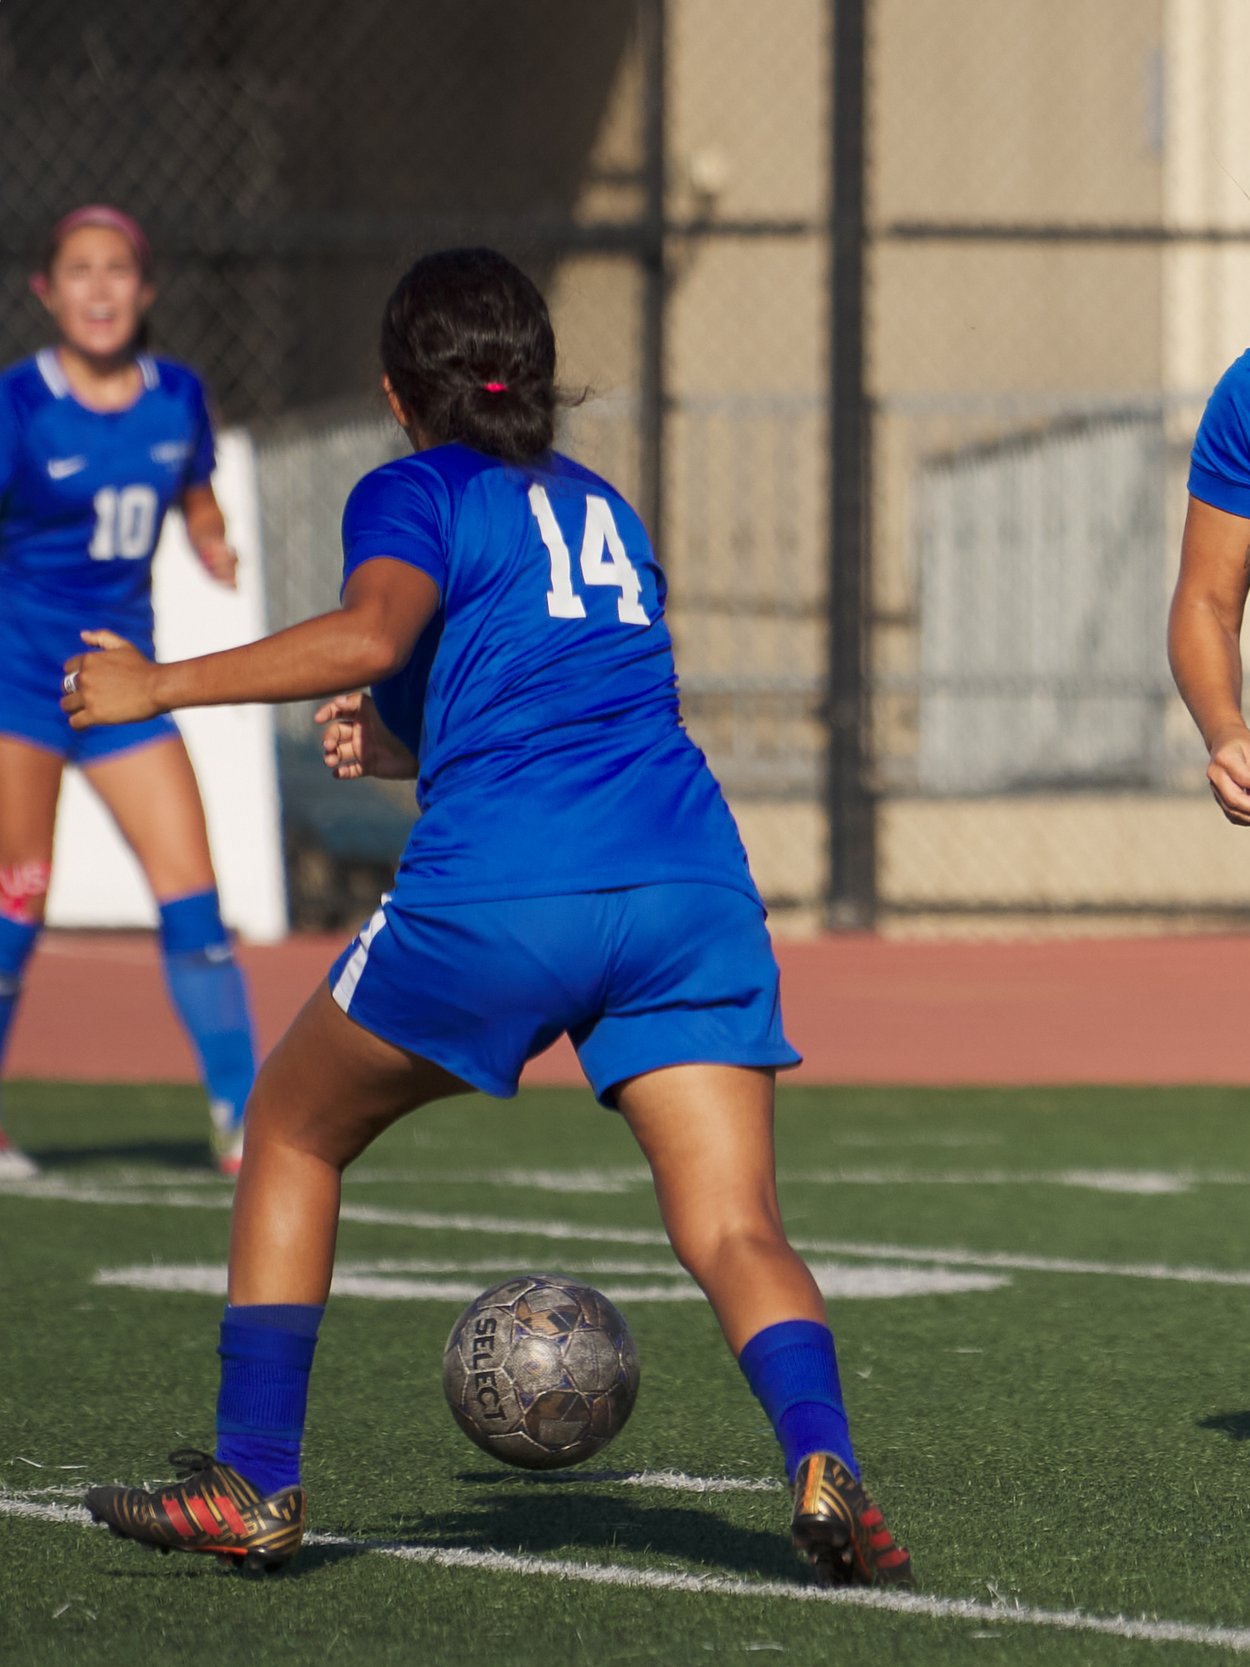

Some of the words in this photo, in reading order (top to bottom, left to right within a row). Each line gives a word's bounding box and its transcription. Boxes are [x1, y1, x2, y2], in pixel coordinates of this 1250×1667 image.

[89, 485, 157, 560] 10
[528, 483, 650, 625] 14
[473, 1317, 507, 1421] SELECT
